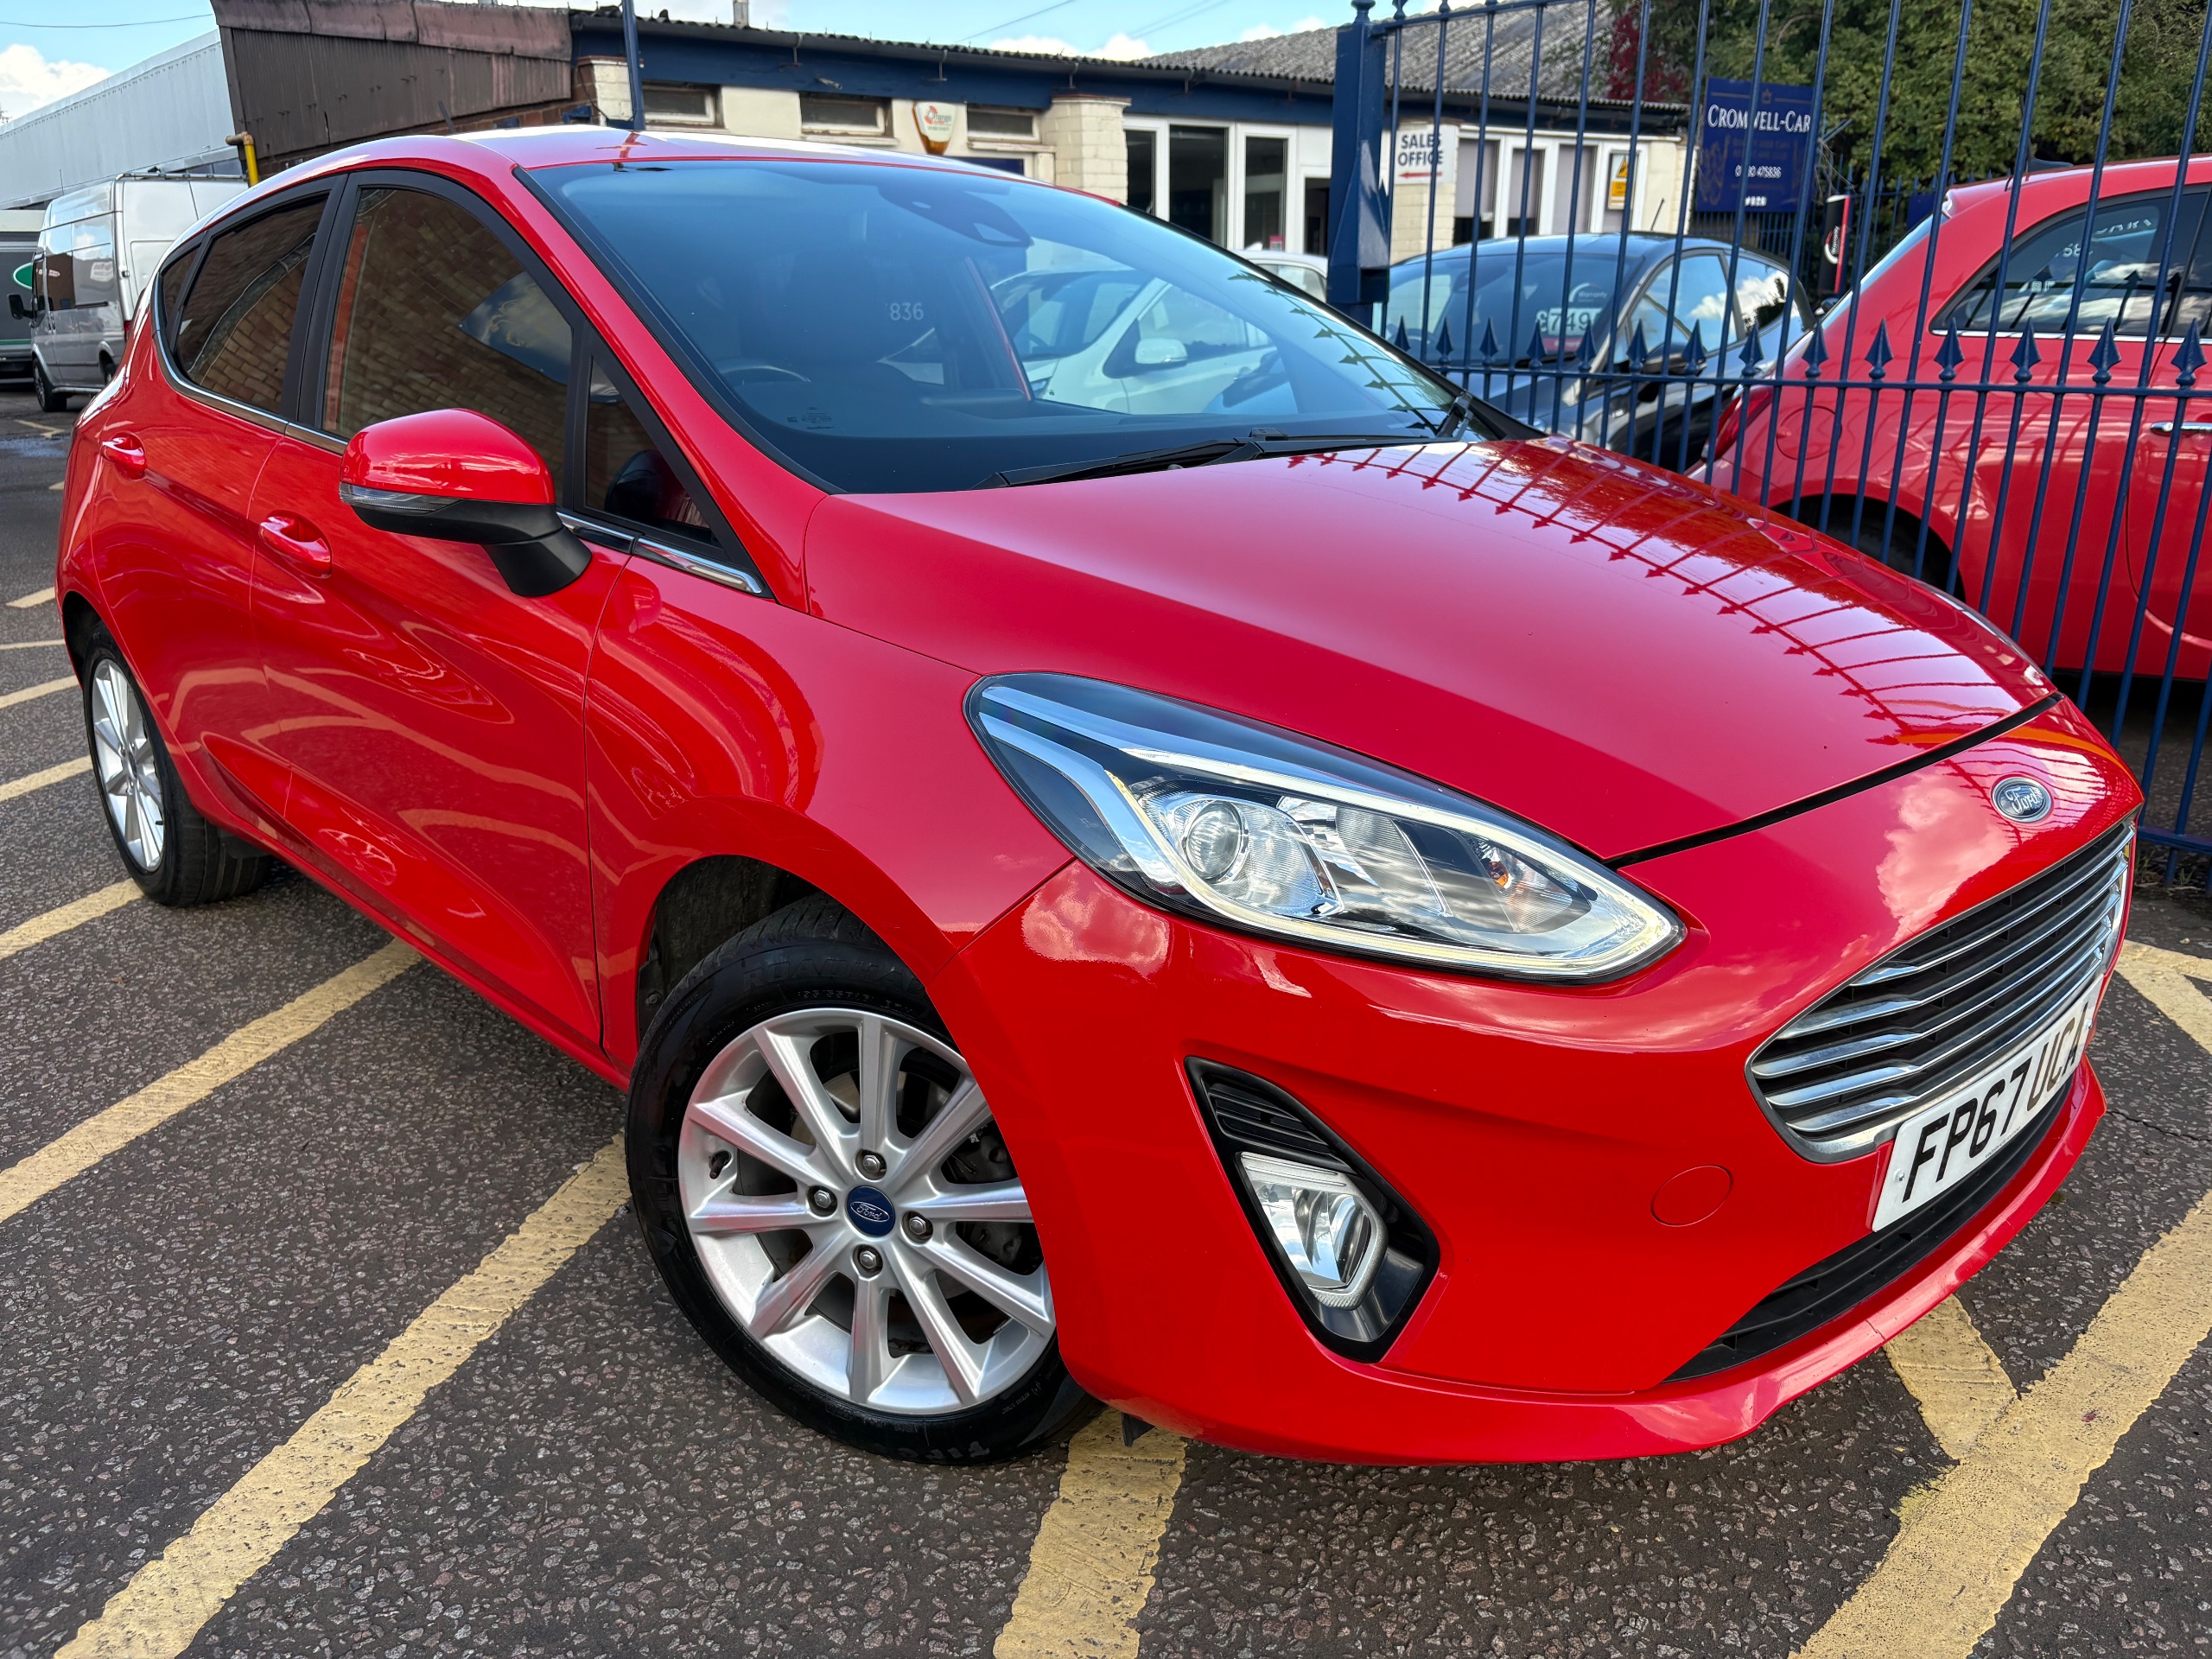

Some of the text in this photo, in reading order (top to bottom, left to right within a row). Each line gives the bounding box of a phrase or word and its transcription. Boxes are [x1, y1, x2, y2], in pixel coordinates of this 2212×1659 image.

[2005, 785, 2042, 814] Ford
[1902, 1055, 2033, 1203] FP67
[856, 1204, 882, 1220] Ford
